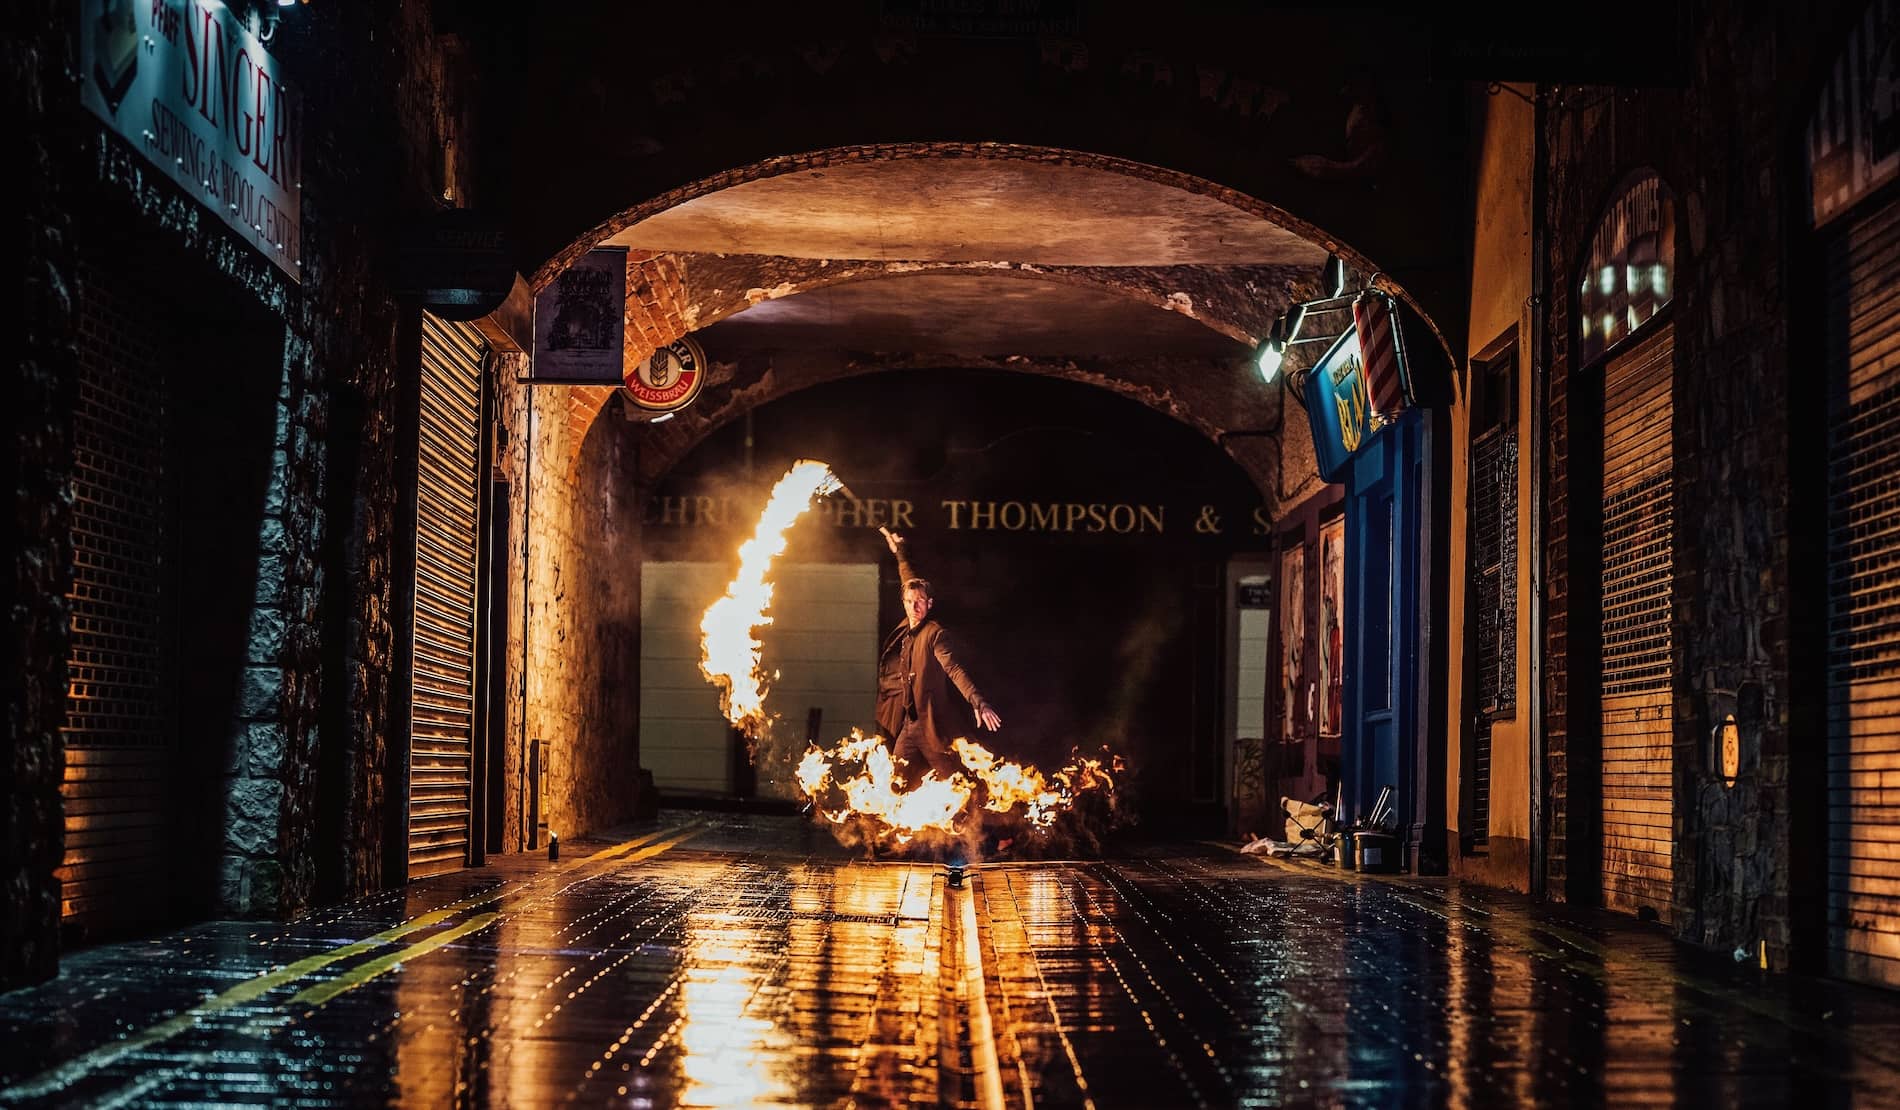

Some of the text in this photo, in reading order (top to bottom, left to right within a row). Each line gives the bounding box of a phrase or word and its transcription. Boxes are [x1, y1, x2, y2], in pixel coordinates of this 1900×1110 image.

[182, 0, 288, 192] SINGER
[152, 98, 205, 187] SEWING
[208, 150, 219, 198] &
[222, 159, 256, 230] WOOL
[942, 499, 1165, 534] THOMPSON
[1194, 505, 1223, 534] &
